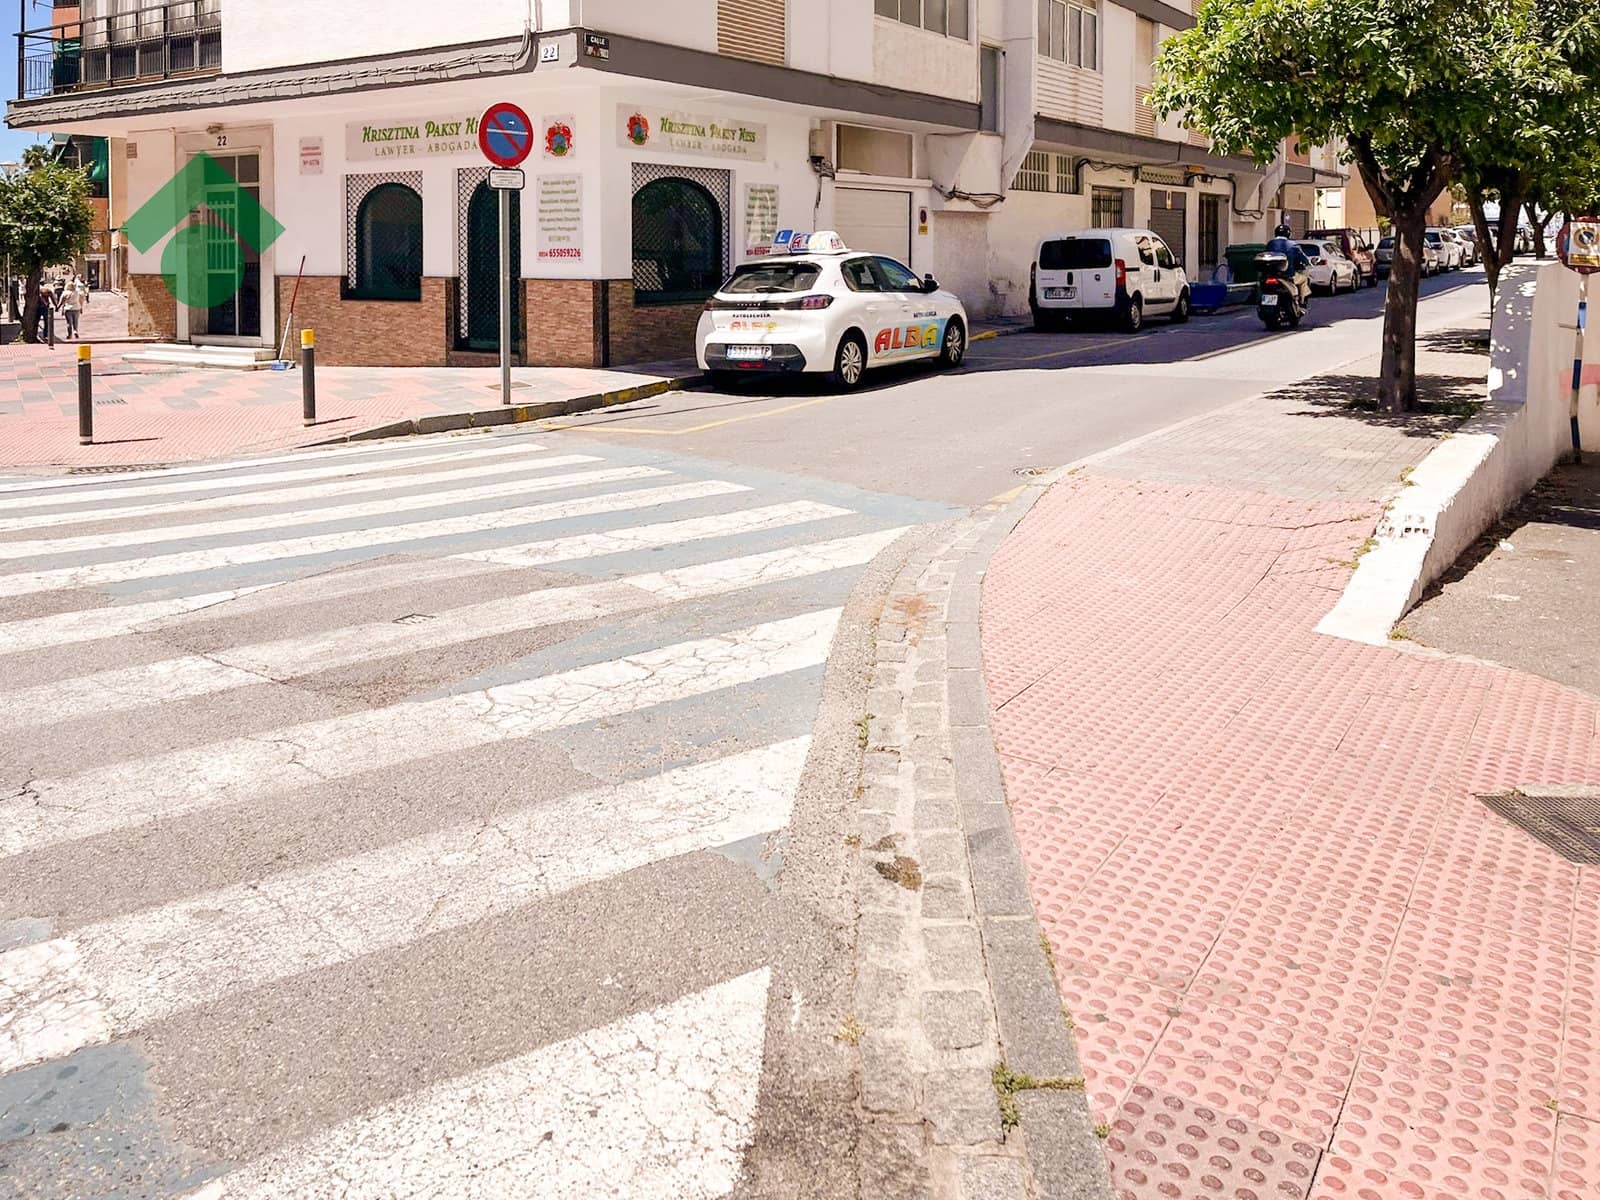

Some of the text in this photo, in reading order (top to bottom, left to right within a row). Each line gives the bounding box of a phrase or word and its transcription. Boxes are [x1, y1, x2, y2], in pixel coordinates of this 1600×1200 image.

[543, 46, 555, 58] 22
[425, 121, 462, 138] PAKSY
[217, 135, 227, 146] 22
[374, 144, 415, 158] LAWYER
[427, 140, 478, 154] ABOGADA
[549, 248, 581, 258] 655059226
[875, 323, 938, 354] ALBA
